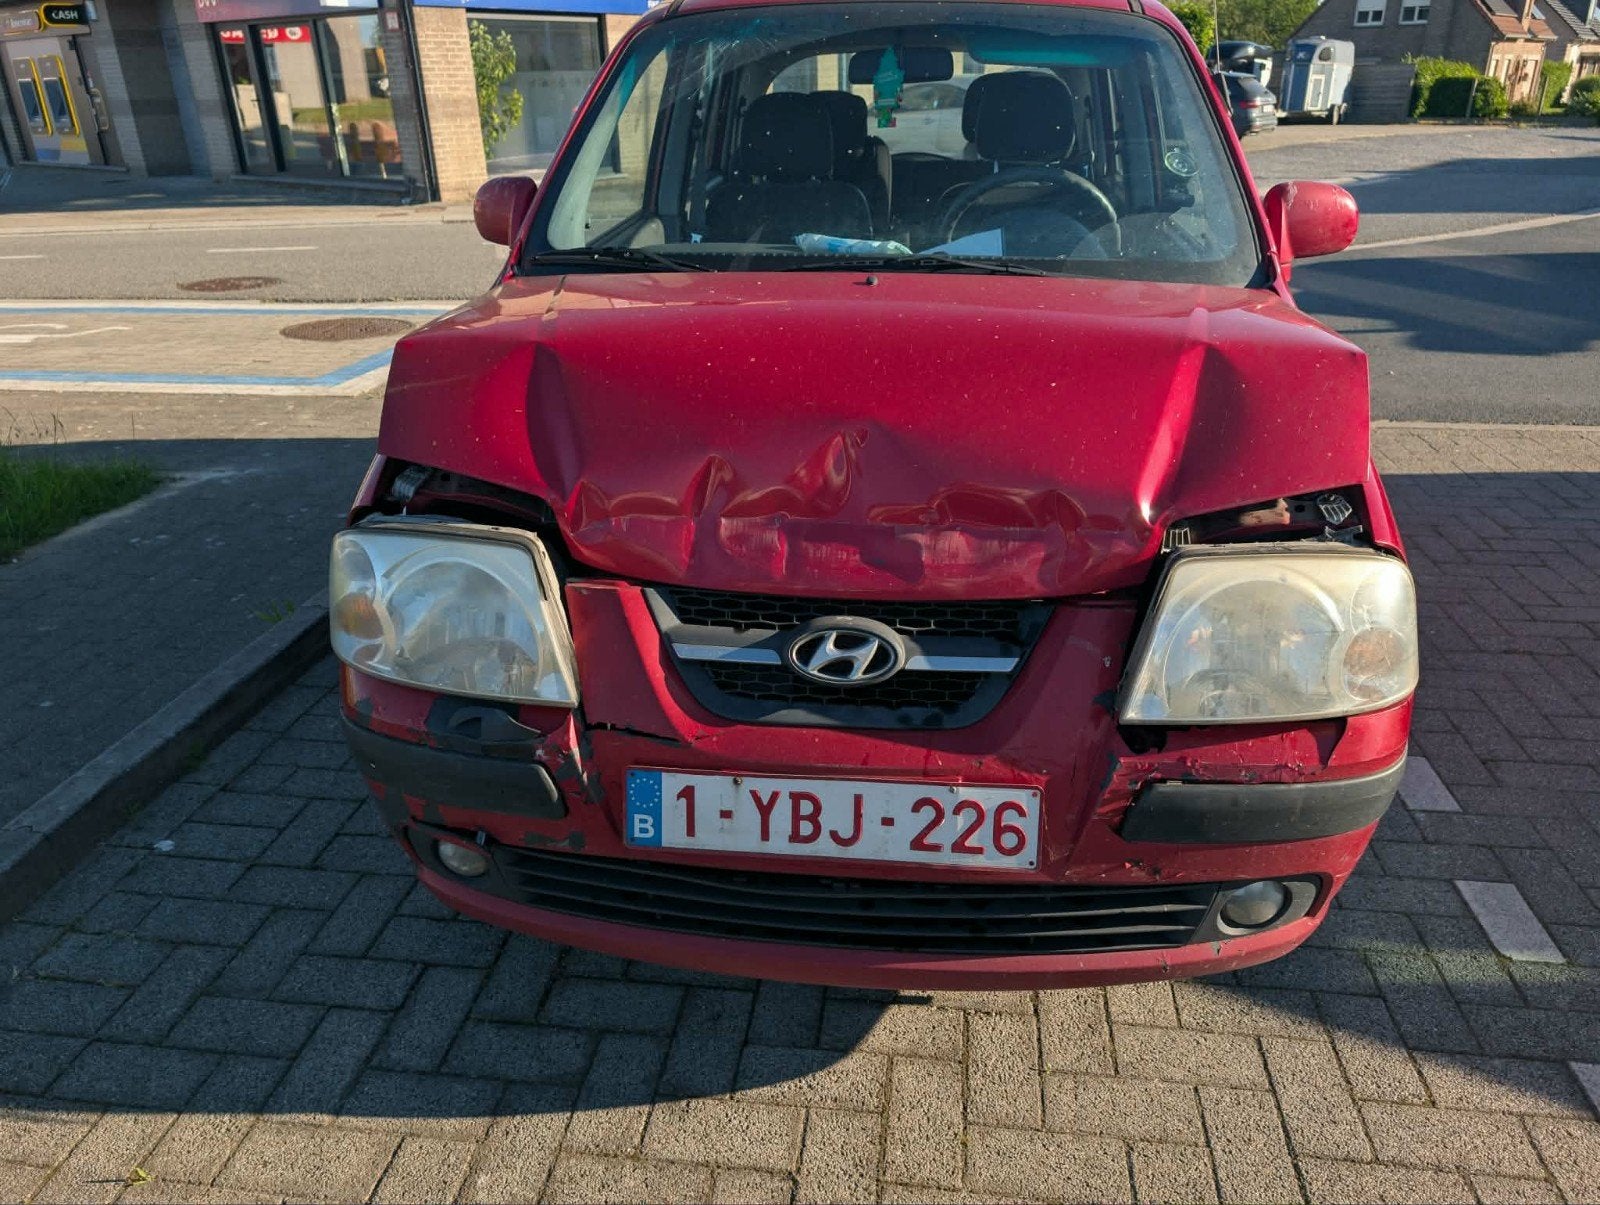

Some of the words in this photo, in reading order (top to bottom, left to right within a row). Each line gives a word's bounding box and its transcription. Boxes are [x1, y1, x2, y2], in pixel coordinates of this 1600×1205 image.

[52, 10, 78, 19] CASH
[633, 813, 655, 838] B
[675, 784, 1028, 857] 1-YBJ-226
